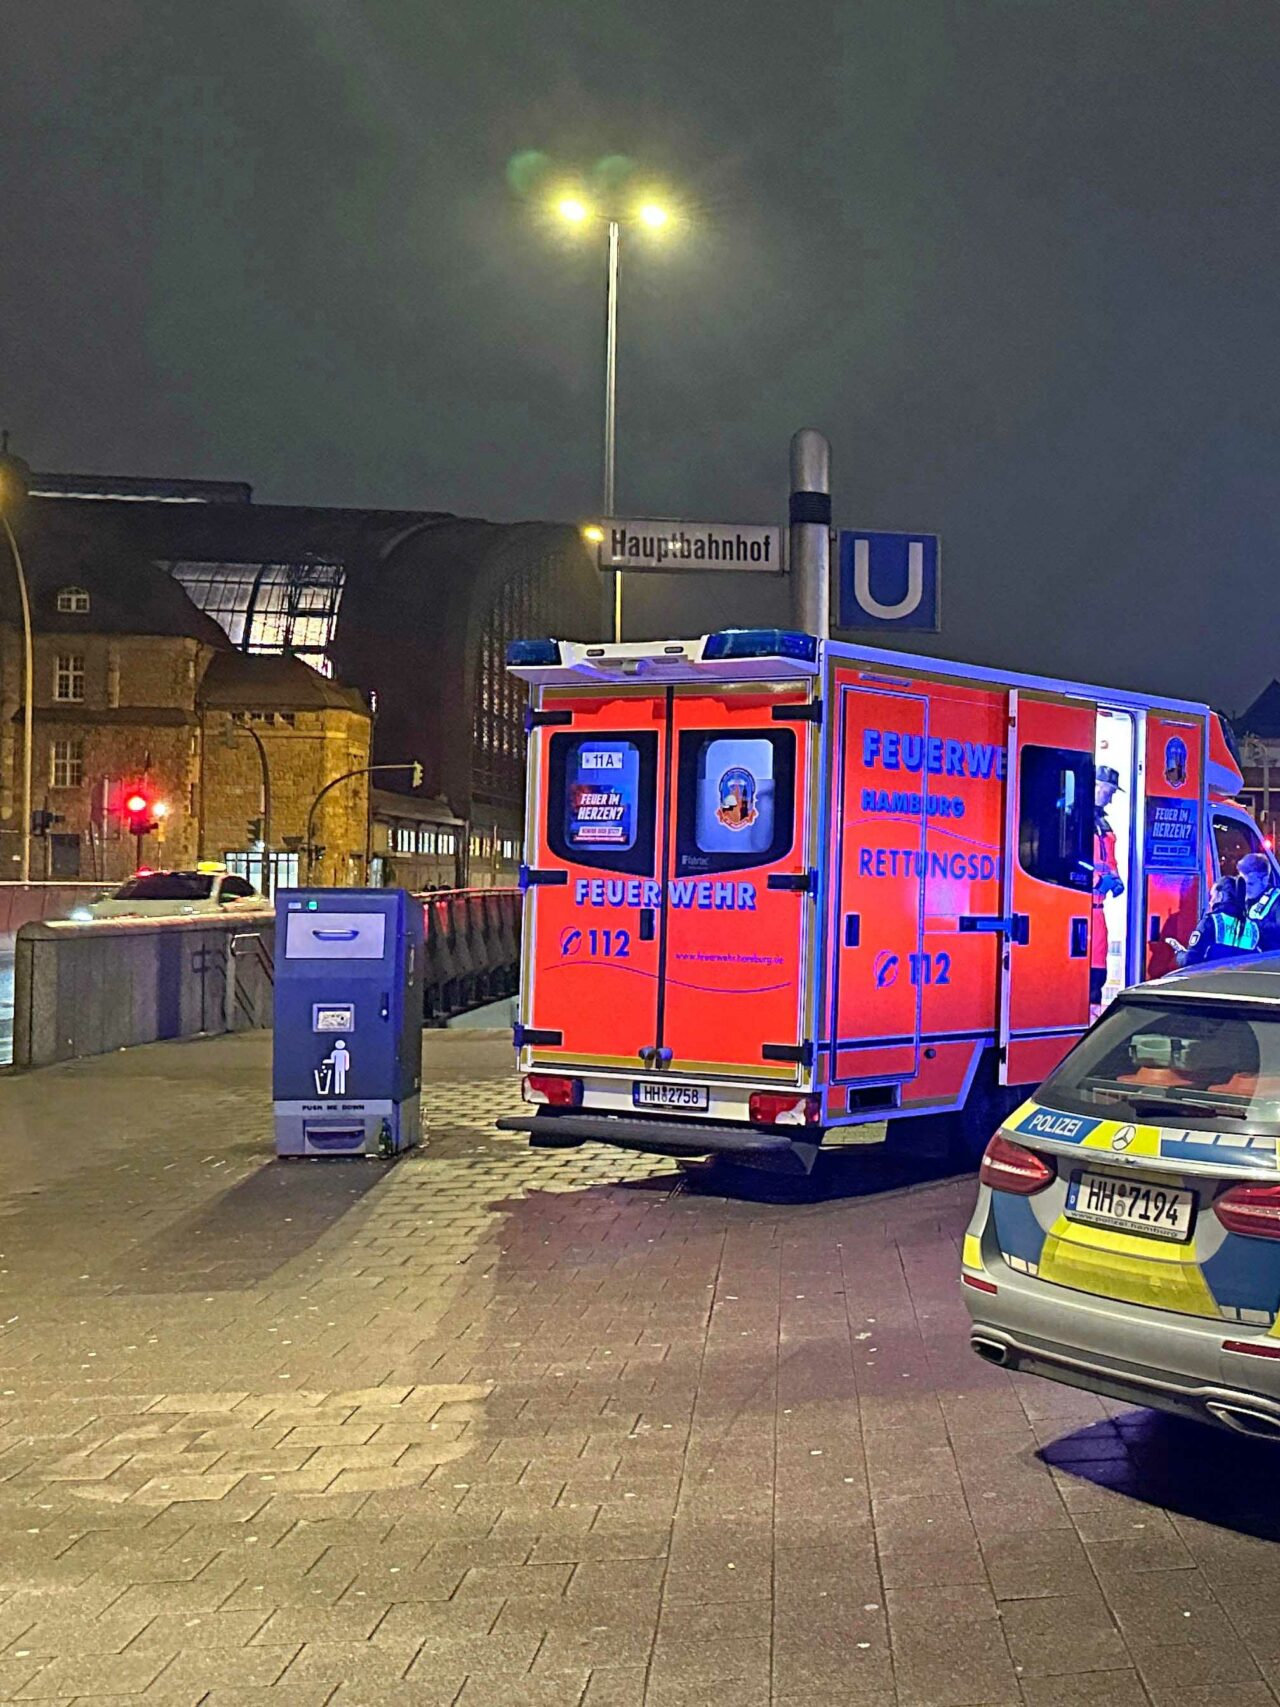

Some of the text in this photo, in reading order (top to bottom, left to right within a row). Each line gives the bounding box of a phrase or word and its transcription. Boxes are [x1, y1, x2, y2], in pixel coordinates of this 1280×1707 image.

[611, 528, 771, 563] Hauptbahnhof
[854, 538, 924, 620] U
[579, 793, 621, 806] FEUER IM
[861, 788, 966, 818] HAMBURG
[577, 806, 624, 821] HERZEN?
[1155, 807, 1178, 821] FEUER
[1152, 822, 1192, 839] HERZEN?
[588, 929, 630, 957] 112
[909, 952, 951, 985] 112
[644, 1085, 660, 1102] HH
[668, 1087, 699, 1105] 2758
[1028, 1114, 1083, 1137] POLIZEI
[1086, 1179, 1116, 1214] HH
[1127, 1186, 1180, 1226] 7194
